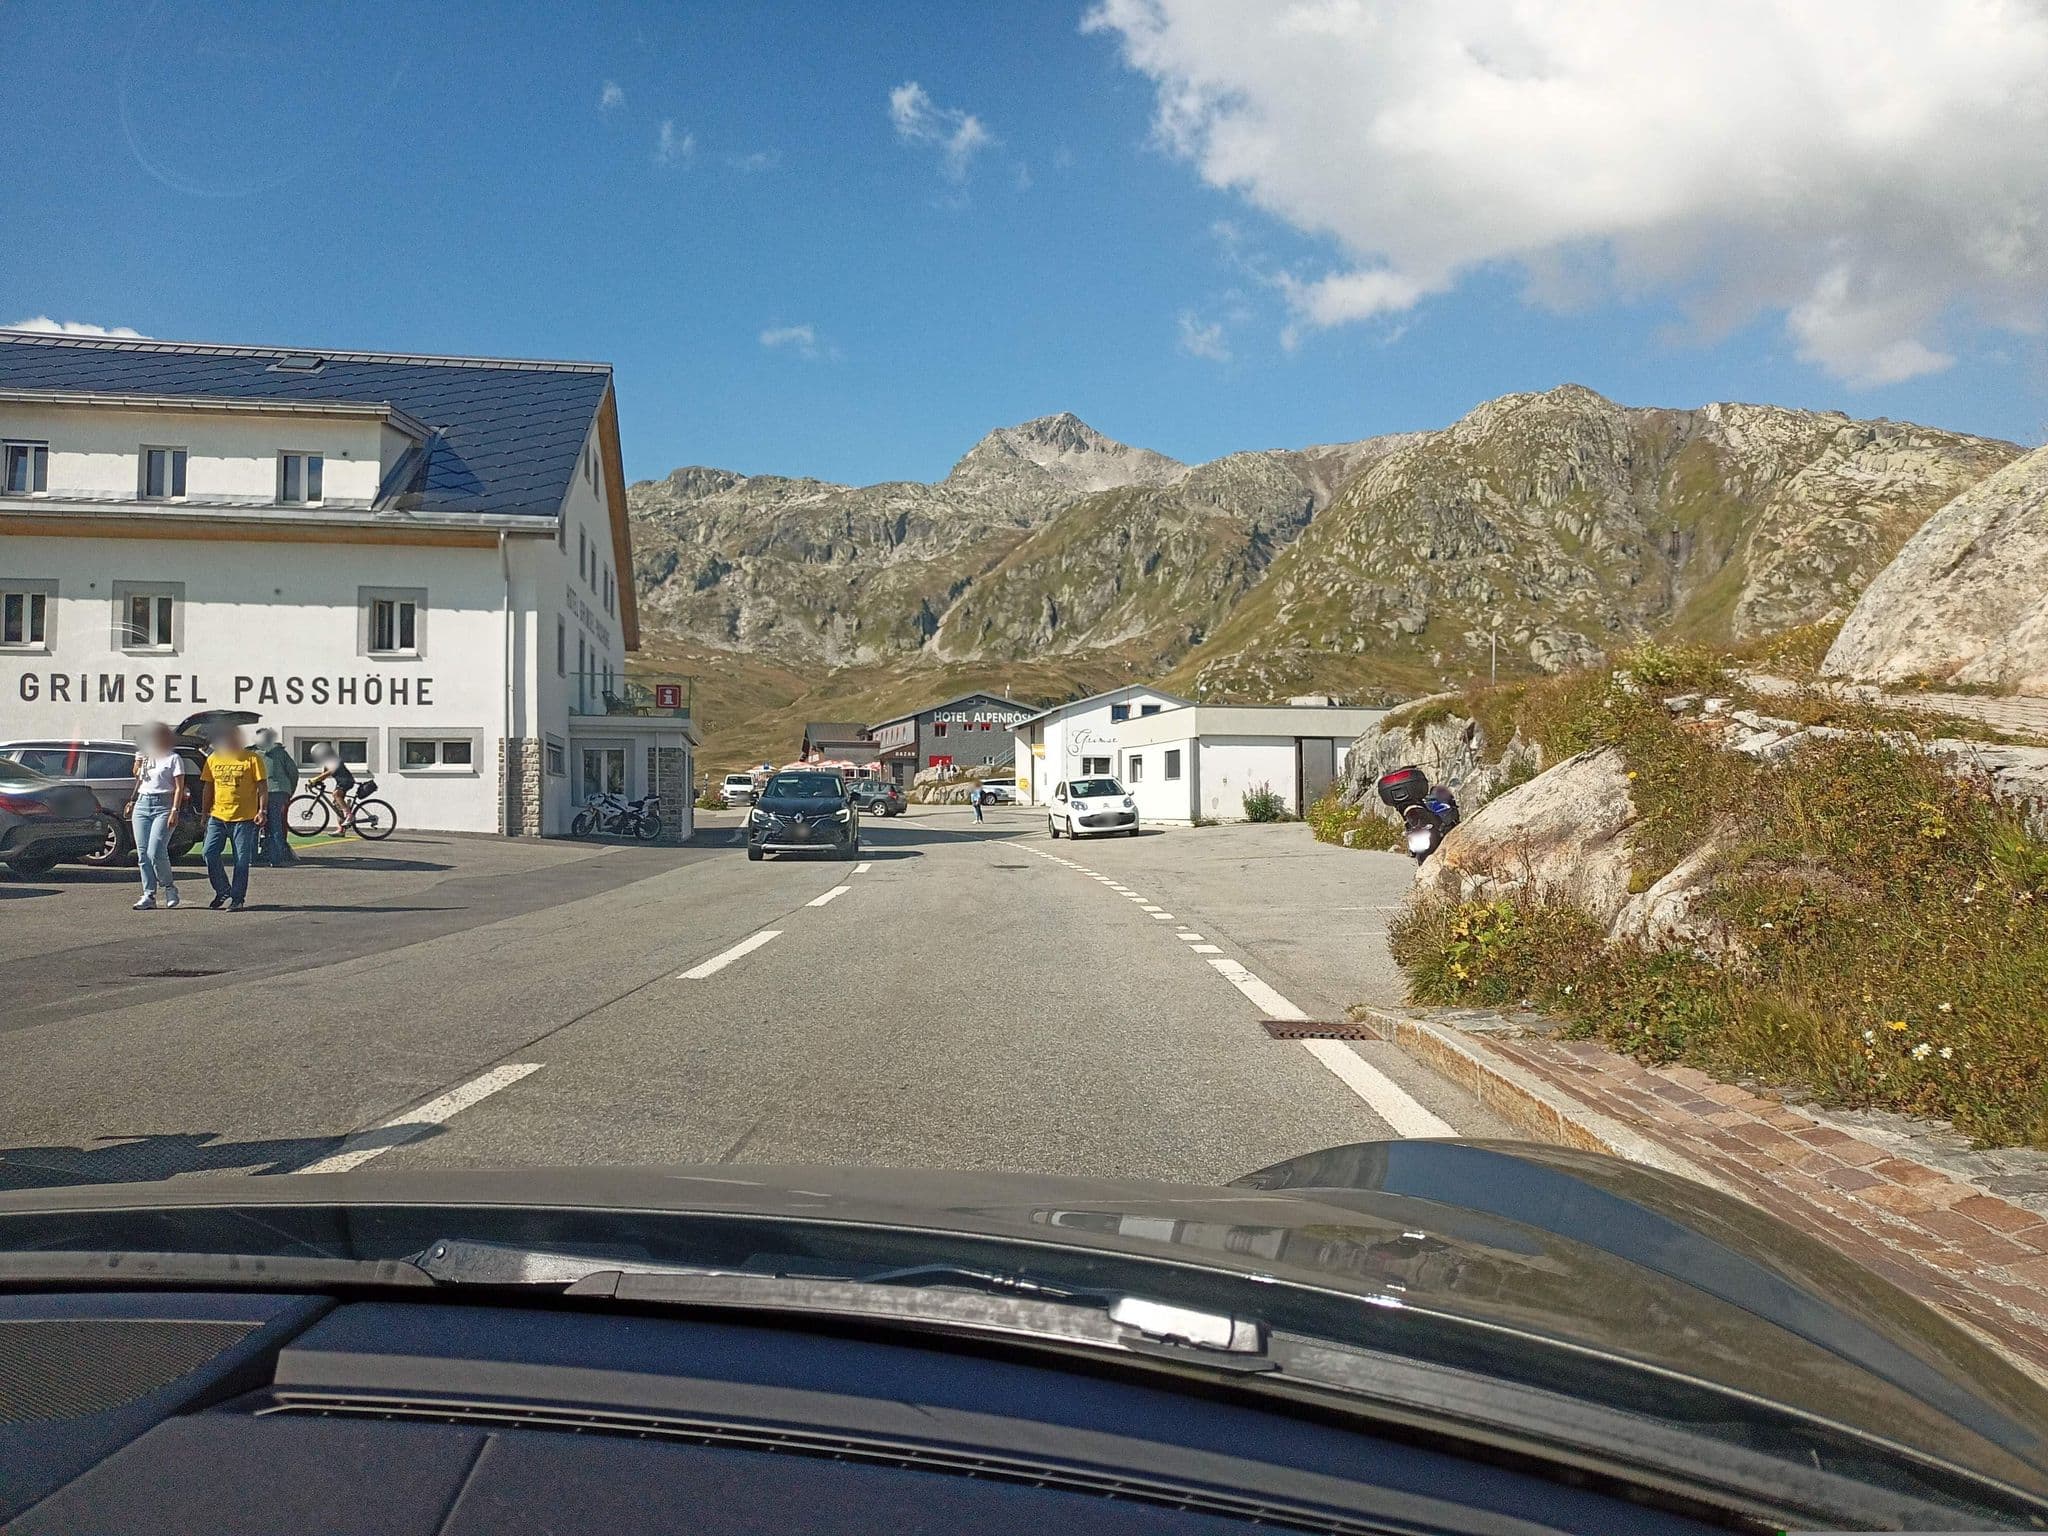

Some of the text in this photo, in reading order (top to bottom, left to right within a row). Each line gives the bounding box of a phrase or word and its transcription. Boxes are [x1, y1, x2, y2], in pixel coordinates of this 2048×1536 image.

[19, 672, 434, 706] GRIMSEL PASSHÖHE
[934, 710, 1034, 723] HOTEL ALPENRÖS
